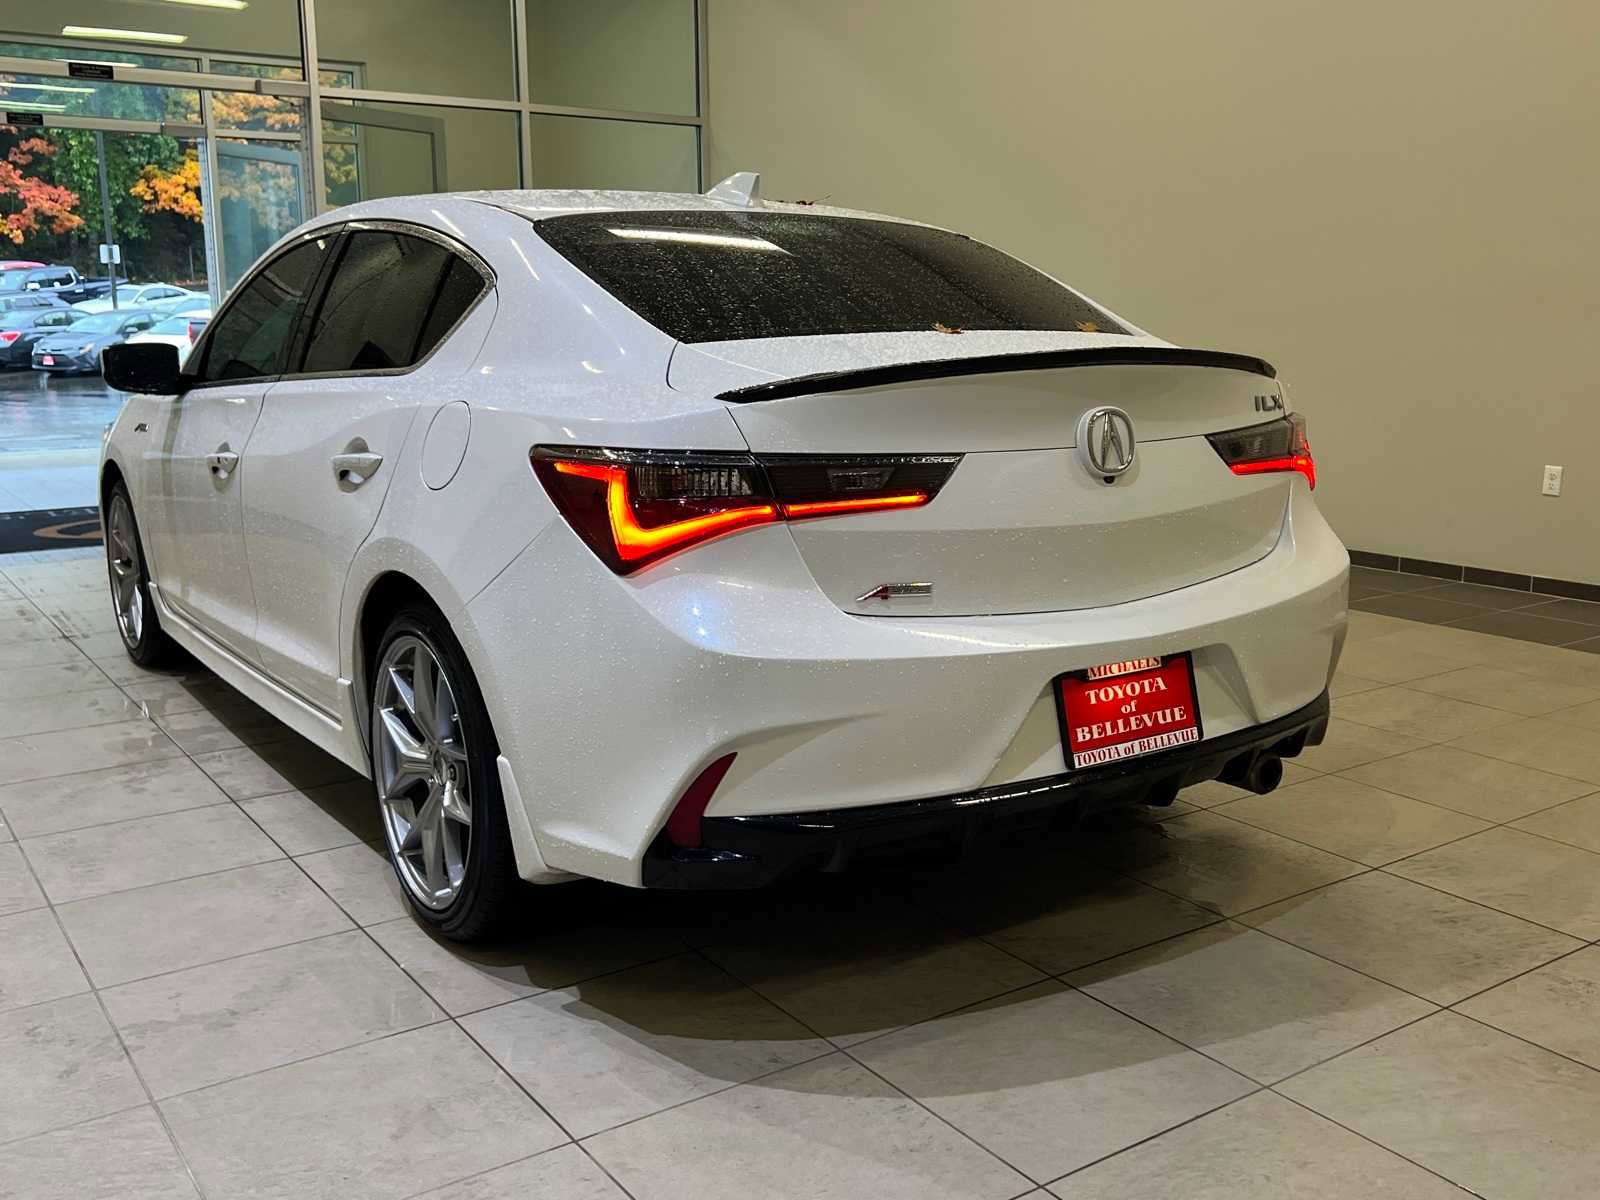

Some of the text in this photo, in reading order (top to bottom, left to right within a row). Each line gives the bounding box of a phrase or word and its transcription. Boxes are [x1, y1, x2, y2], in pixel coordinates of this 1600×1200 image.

[1254, 394, 1283, 411] ILX
[1085, 677, 1167, 705] TOYOTA
[1121, 700, 1137, 714] of
[1075, 706, 1187, 743] BELLEVUE
[1075, 728, 1198, 767] TOYOTA of BELLEVUE
